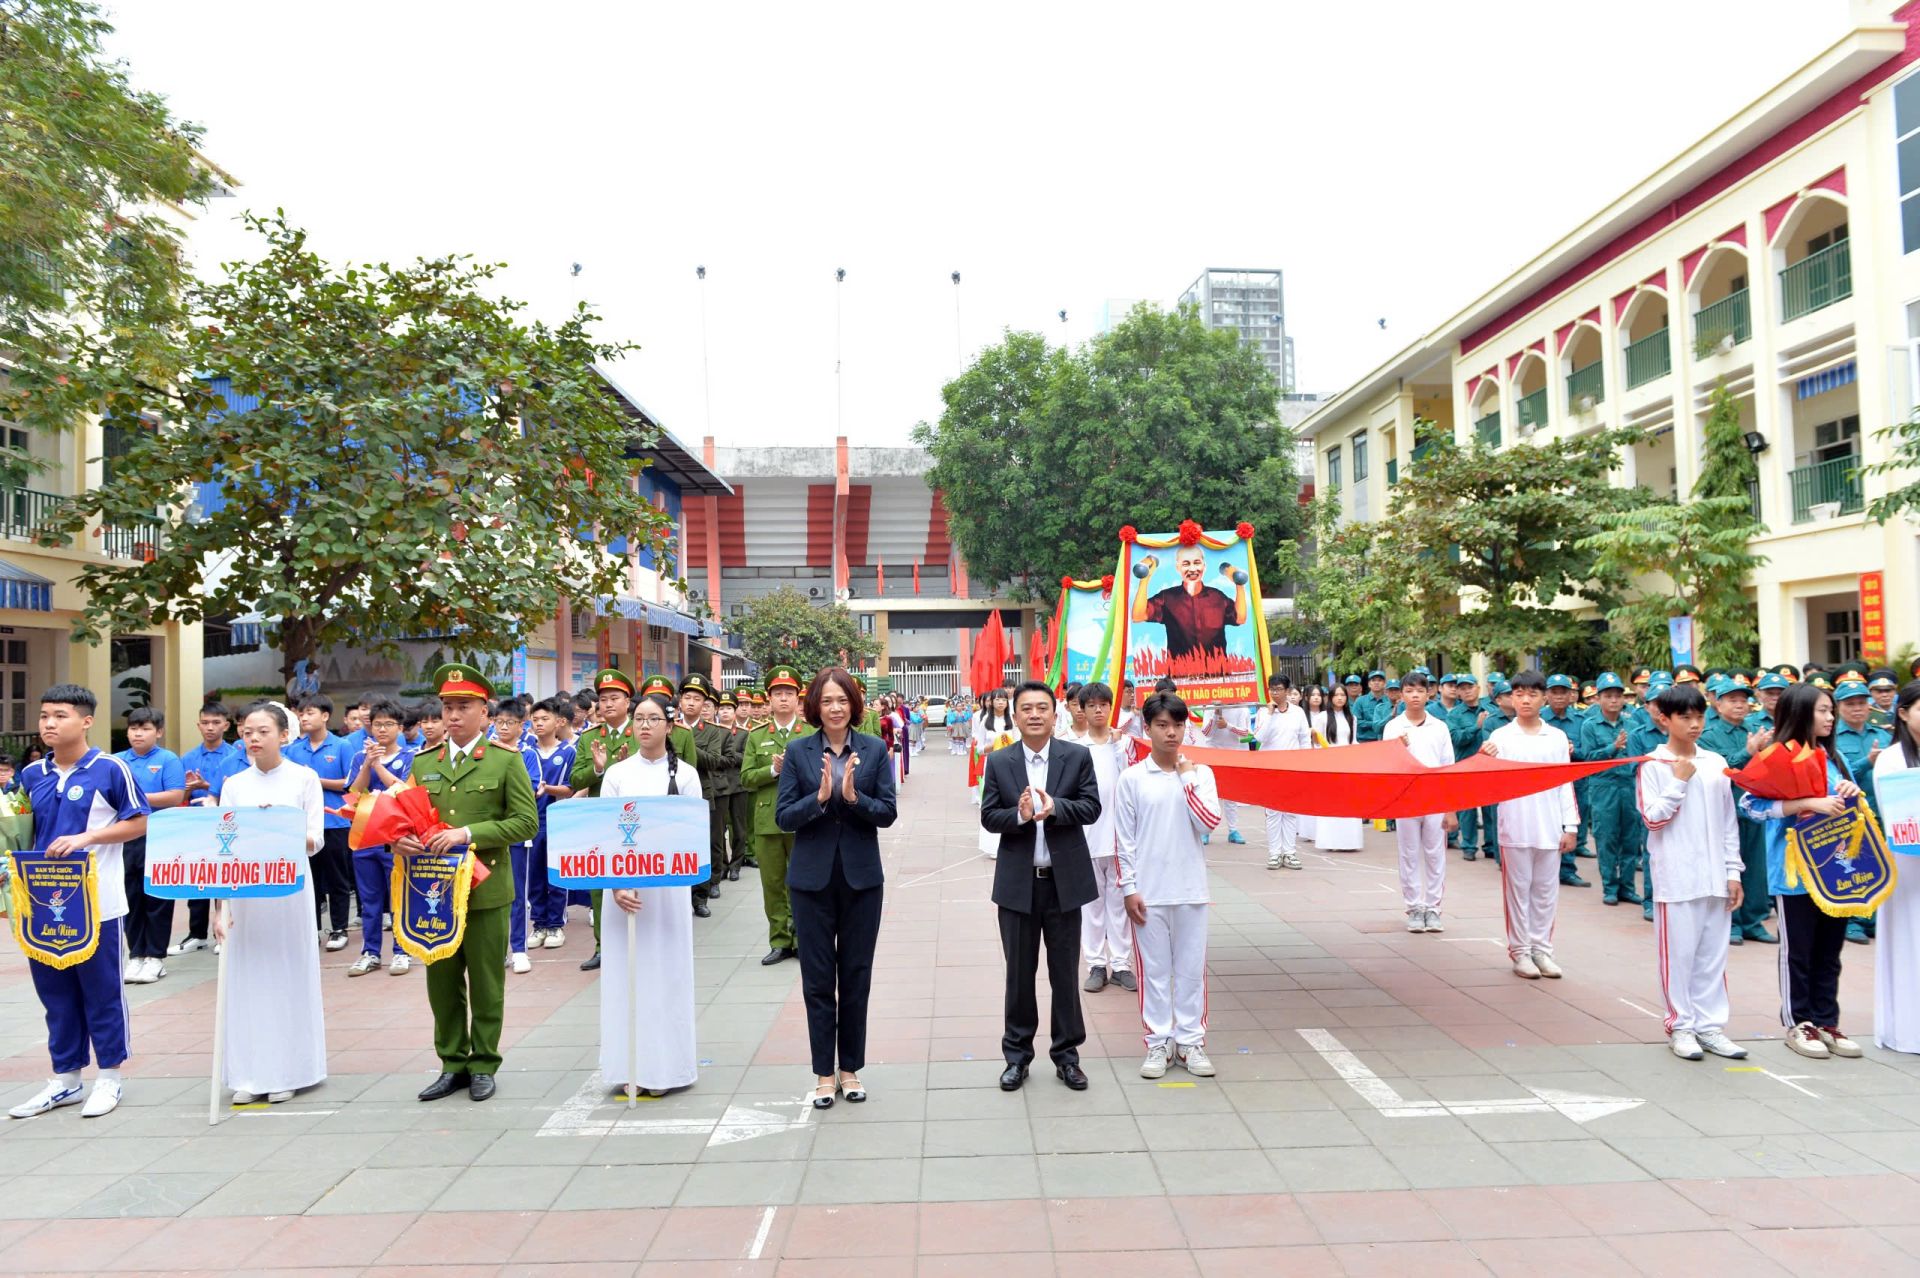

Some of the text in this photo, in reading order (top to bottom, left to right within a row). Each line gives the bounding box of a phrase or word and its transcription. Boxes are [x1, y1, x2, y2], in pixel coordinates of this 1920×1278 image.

[1193, 686, 1210, 700] NÀO
[1211, 685, 1234, 699] CŨNG
[1236, 685, 1251, 700] TẬP
[151, 855, 296, 890] KHỐI VẬN ĐỘNG VIÊN
[560, 847, 698, 877] KHỐI CÔNG AN
[42, 924, 56, 936] Lưu
